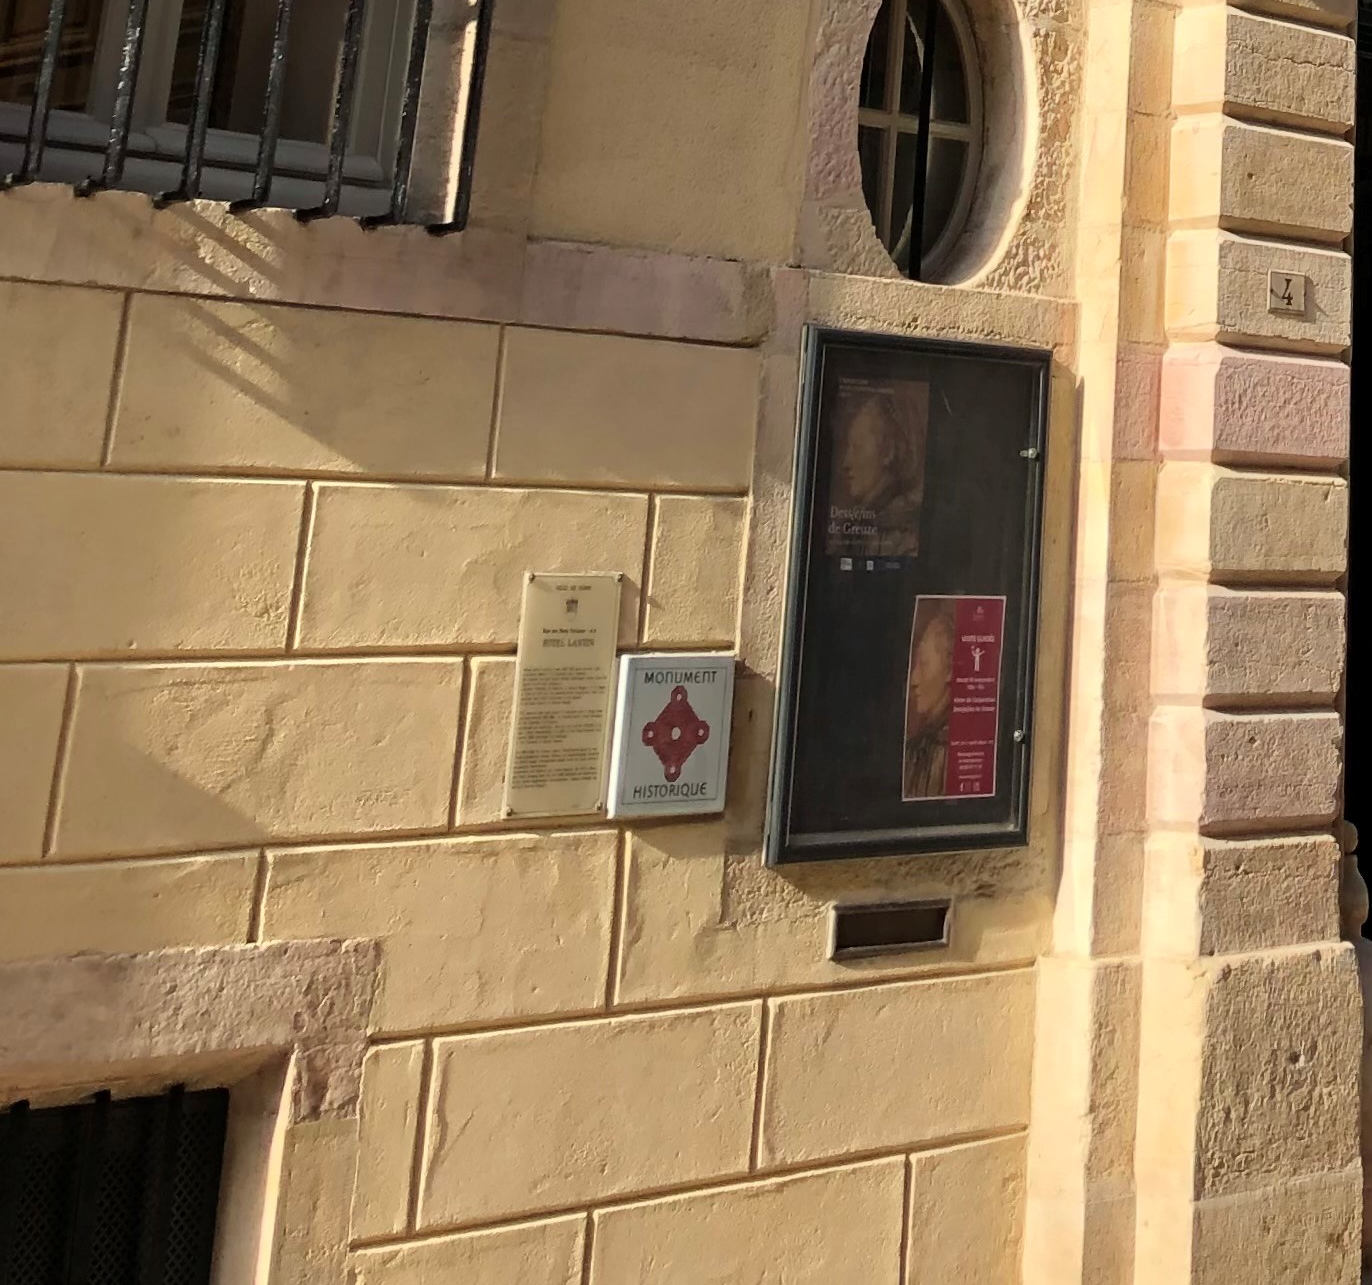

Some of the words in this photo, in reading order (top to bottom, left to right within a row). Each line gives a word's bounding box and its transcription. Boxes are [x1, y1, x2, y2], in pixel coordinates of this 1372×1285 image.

[1281, 278, 1294, 306] 4
[643, 670, 718, 684] MONUMENT
[632, 782, 708, 799] HISTORIQUE
